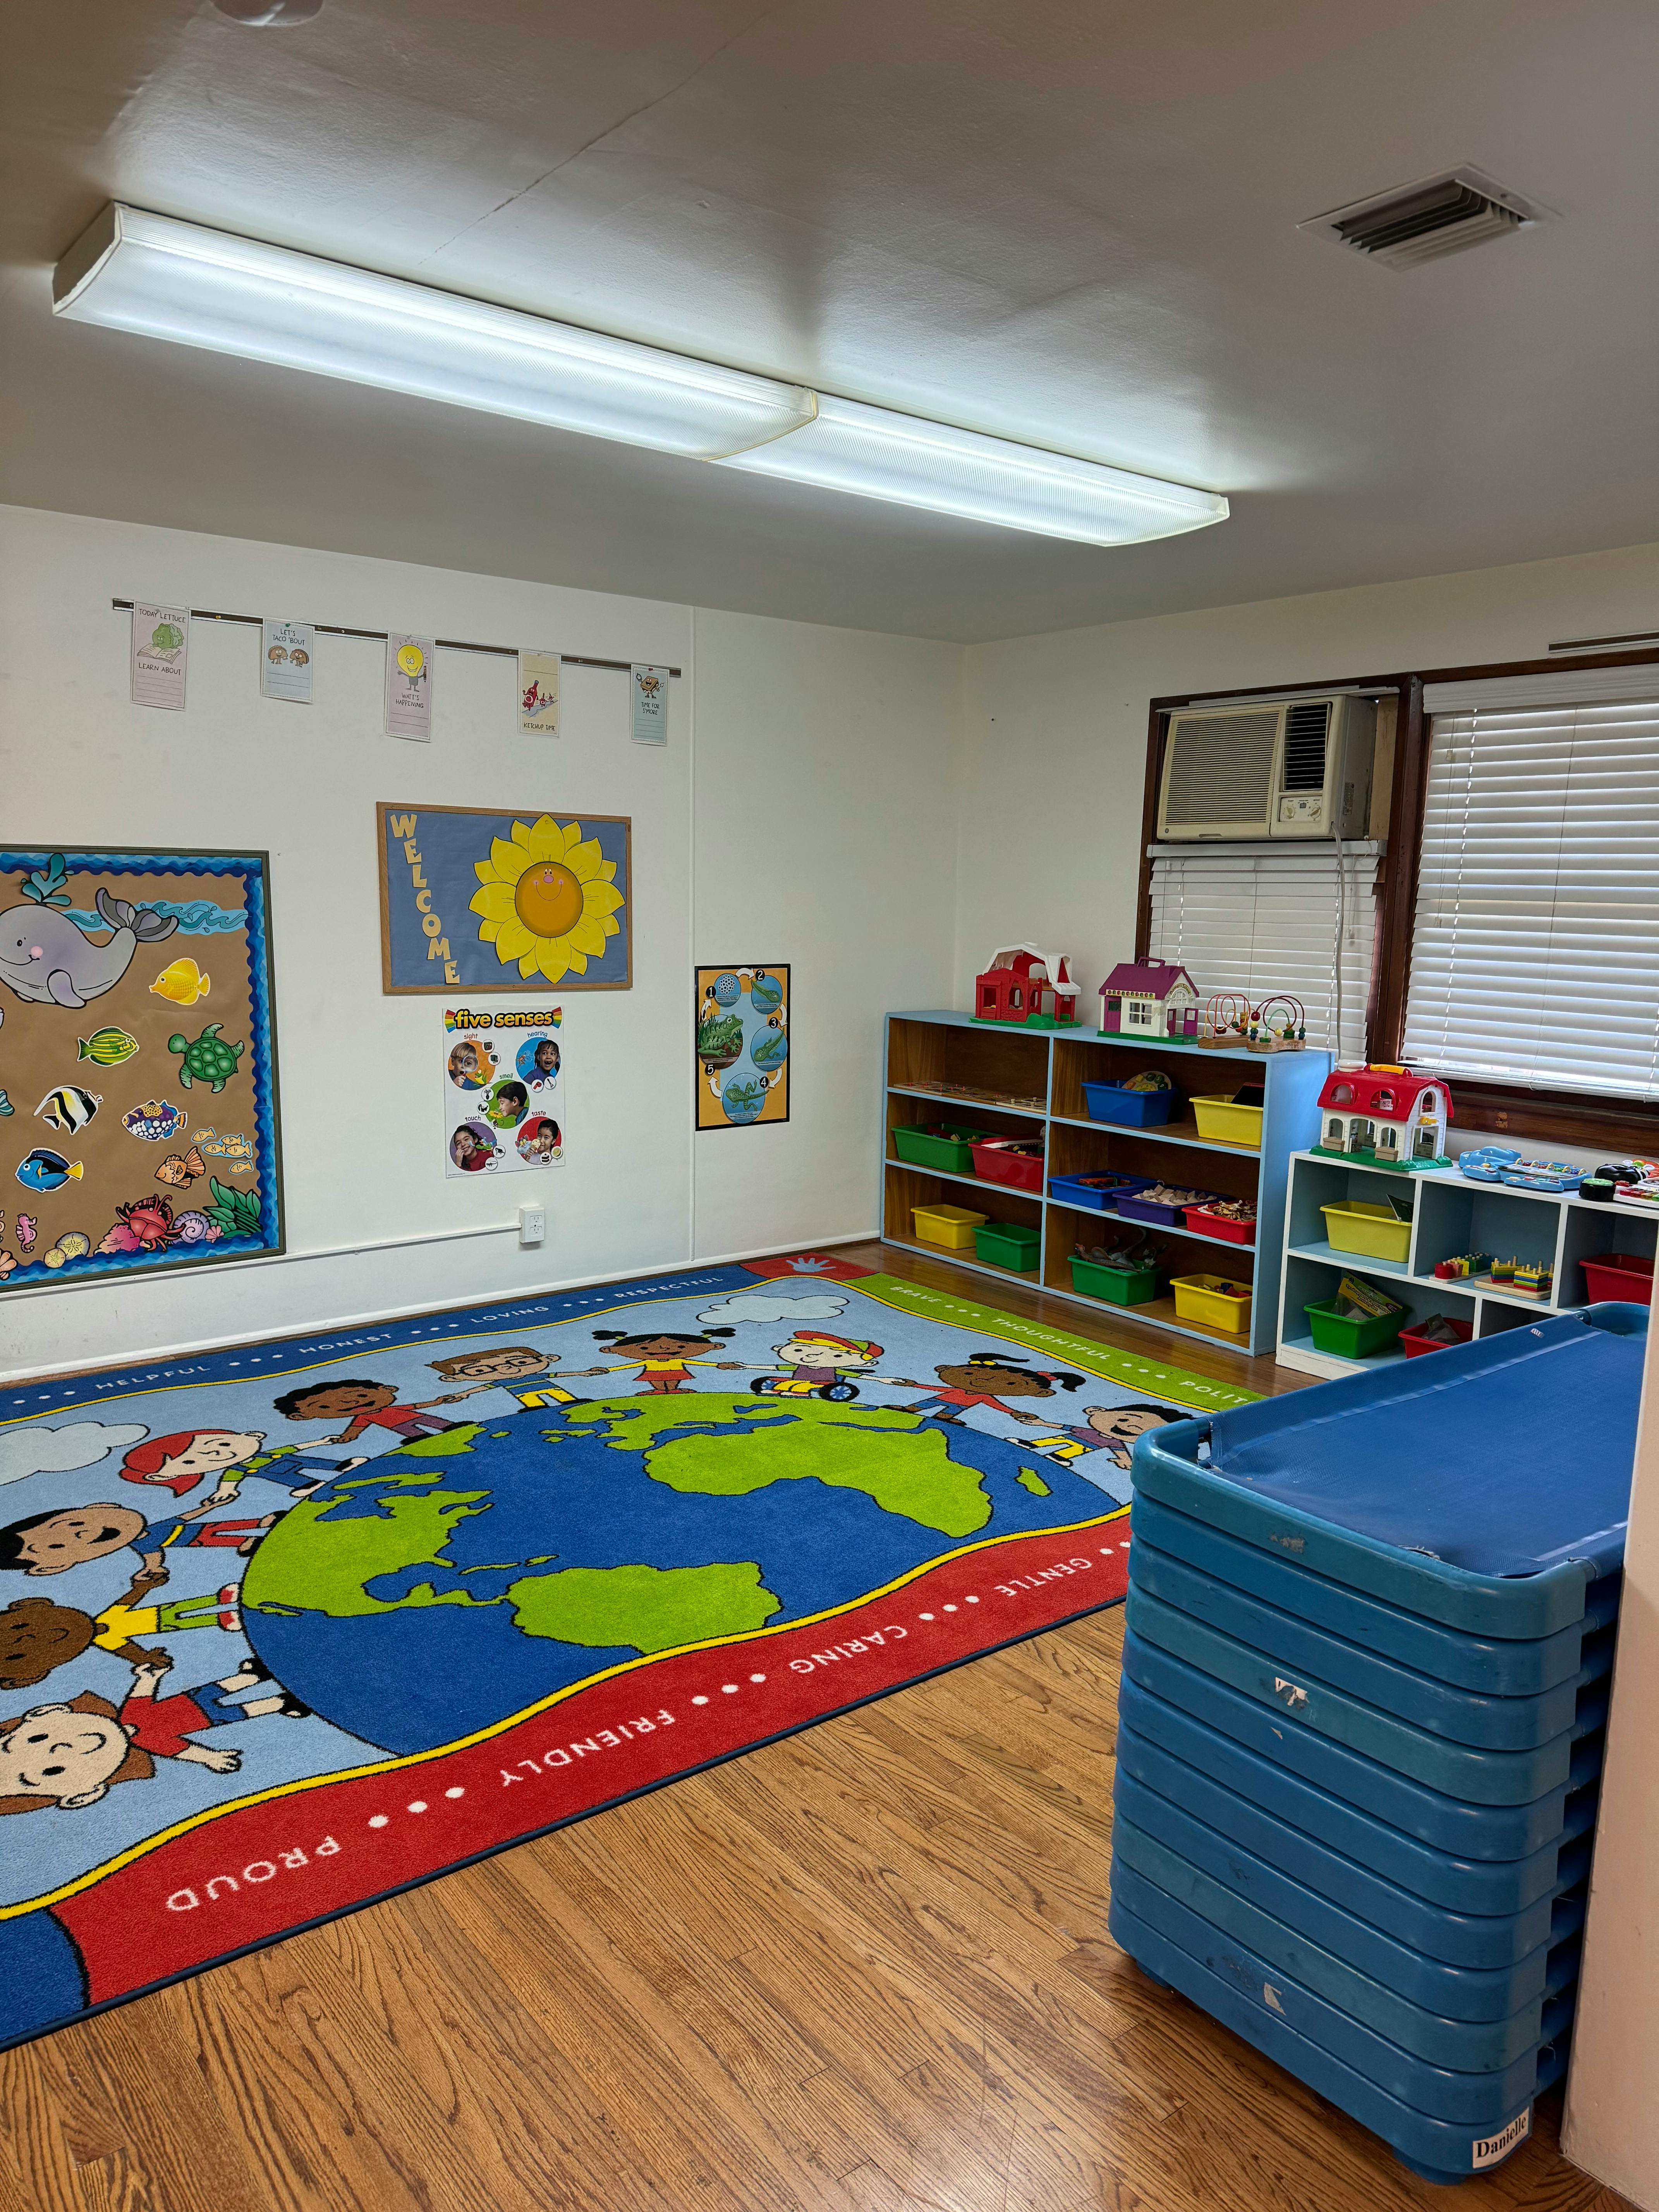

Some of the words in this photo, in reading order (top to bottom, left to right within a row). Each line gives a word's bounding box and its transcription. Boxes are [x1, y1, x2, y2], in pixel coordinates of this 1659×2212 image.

[139, 609, 158, 617] TODAY
[160, 613, 186, 623] LETTUCE
[280, 628, 295, 636] LET'S
[289, 637, 305, 646] 'BOUT
[139, 662, 159, 671] LEARN
[161, 667, 181, 675] ABOUT
[396, 699, 424, 708] HAPPENING
[390, 814, 460, 984] WELCOME
[757, 970, 763, 980] 2
[709, 987, 713, 997] 1
[455, 1010, 491, 1028] five
[494, 1012, 553, 1027] senses
[771, 1018, 776, 1029] 3
[527, 1030, 548, 1038] hearing
[708, 1064, 713, 1075] 5
[761, 1077, 766, 1087] 4
[614, 1278, 724, 1297] RESPECTFUL
[890, 1286, 942, 1303] BRAVE
[471, 1306, 549, 1323] LOVING
[299, 1334, 391, 1353] HONEST
[992, 1318, 1111, 1360] THOUGHTFUL
[96, 1365, 211, 1389] HELPFUL
[1179, 1381, 1254, 1405] POLIT
[994, 1558, 1092, 1597] GENTLE
[789, 1625, 907, 1673] CARING
[500, 1709, 675, 1786] FRIENDLY
[167, 1836, 342, 1911] PROUD
[1476, 2116, 1526, 2158] Danielle
